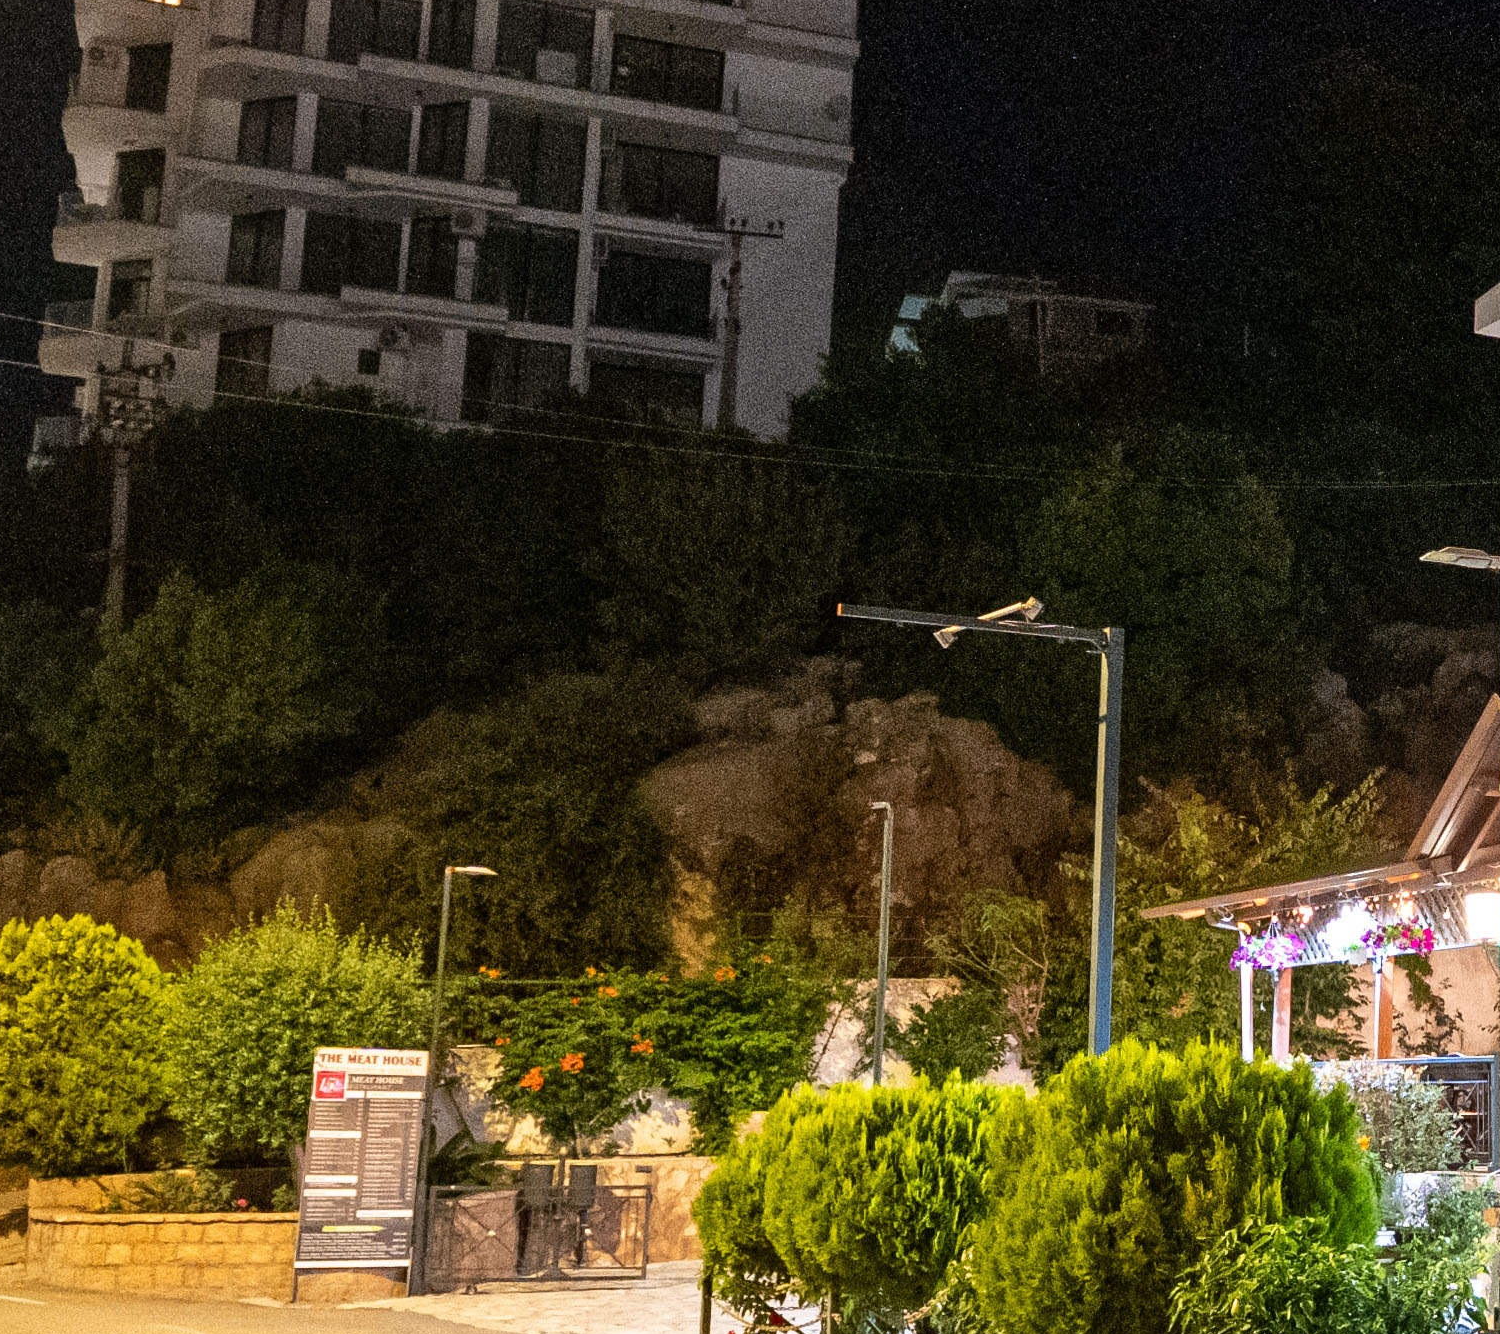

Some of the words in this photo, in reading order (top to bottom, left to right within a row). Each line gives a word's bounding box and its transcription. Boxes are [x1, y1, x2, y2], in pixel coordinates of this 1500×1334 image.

[320, 1053, 343, 1064] THE
[347, 1054, 379, 1065] MEAT
[382, 1055, 423, 1067] HOUSE
[351, 1076, 375, 1085] MEAT
[375, 1076, 405, 1086] HOUSE
